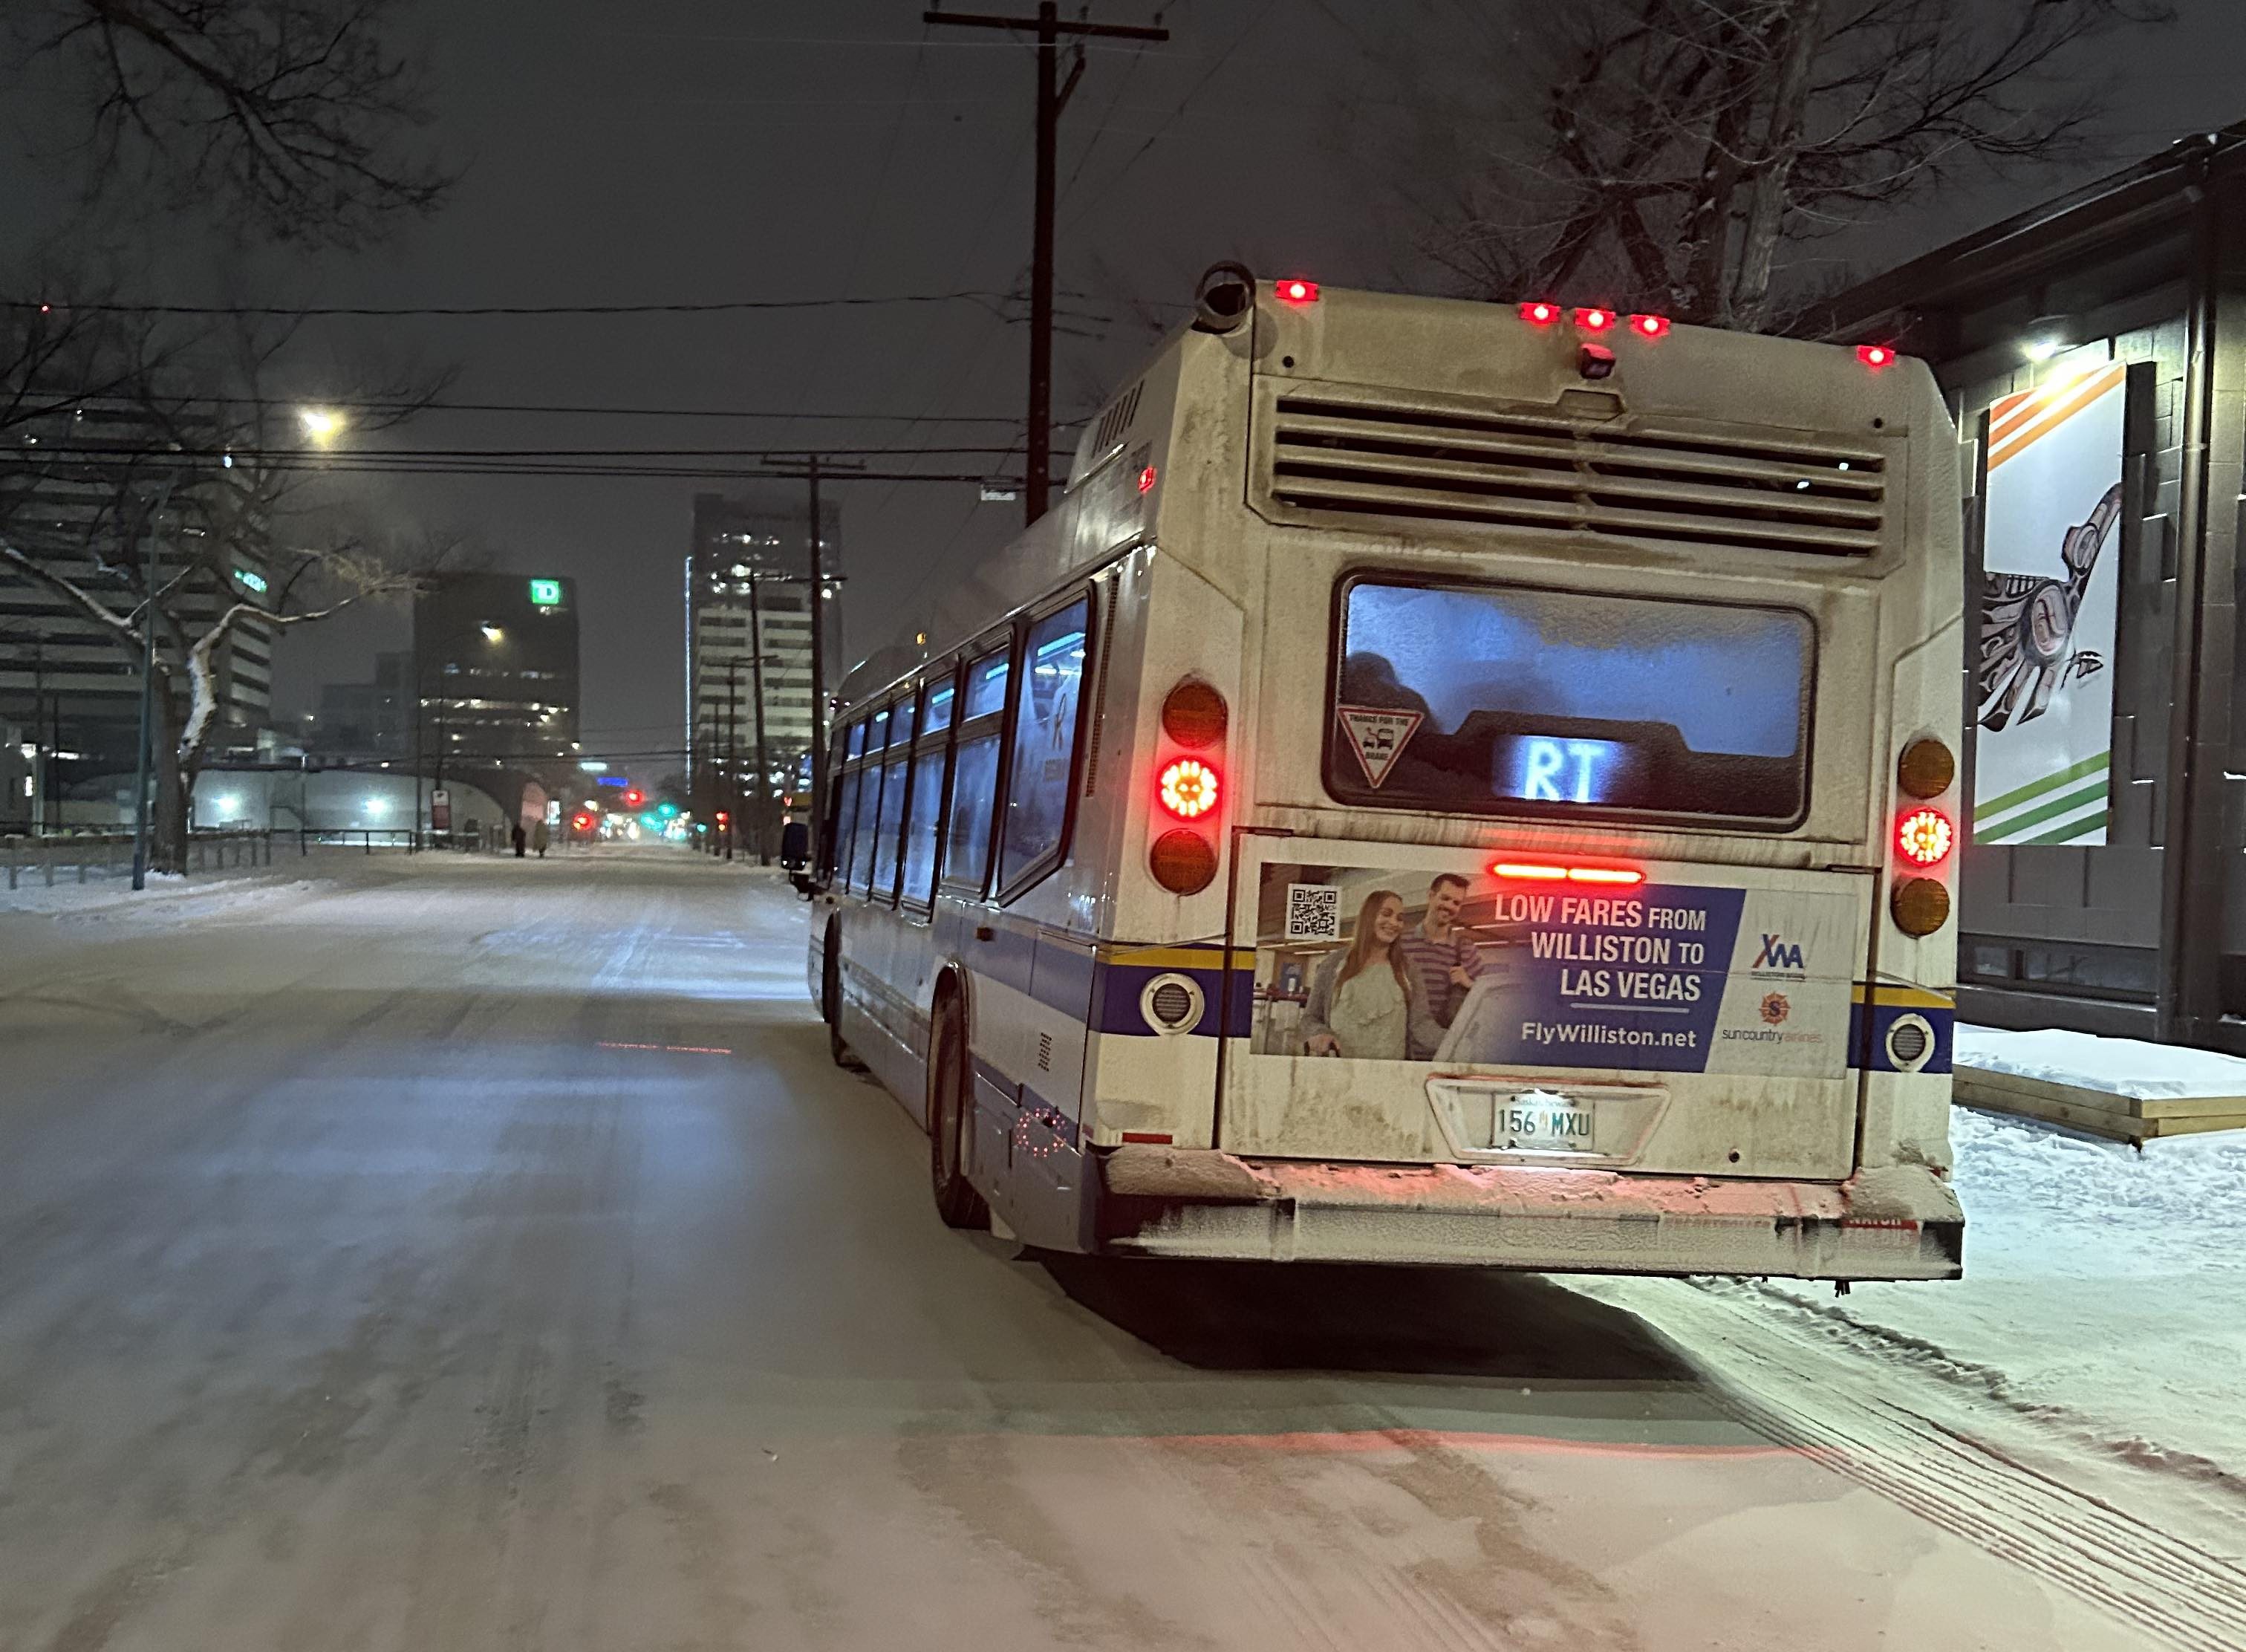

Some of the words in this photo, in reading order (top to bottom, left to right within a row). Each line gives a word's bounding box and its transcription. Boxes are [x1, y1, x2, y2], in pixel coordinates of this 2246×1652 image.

[532, 582, 558, 600] TD
[1526, 740, 1606, 802] RT
[1494, 894, 1555, 923] LOW
[1560, 897, 1642, 928] FARES
[1647, 907, 1706, 931] FROM
[1531, 931, 1670, 964] WILLISTON
[1679, 943, 1705, 964] TO
[1560, 969, 1610, 997] LAS
[1617, 971, 1701, 1001] VEGAS
[1522, 1022, 1696, 1047] FlyWilliston.net
[1499, 1109, 1535, 1135] 156
[1552, 1112, 1589, 1136] MXU
